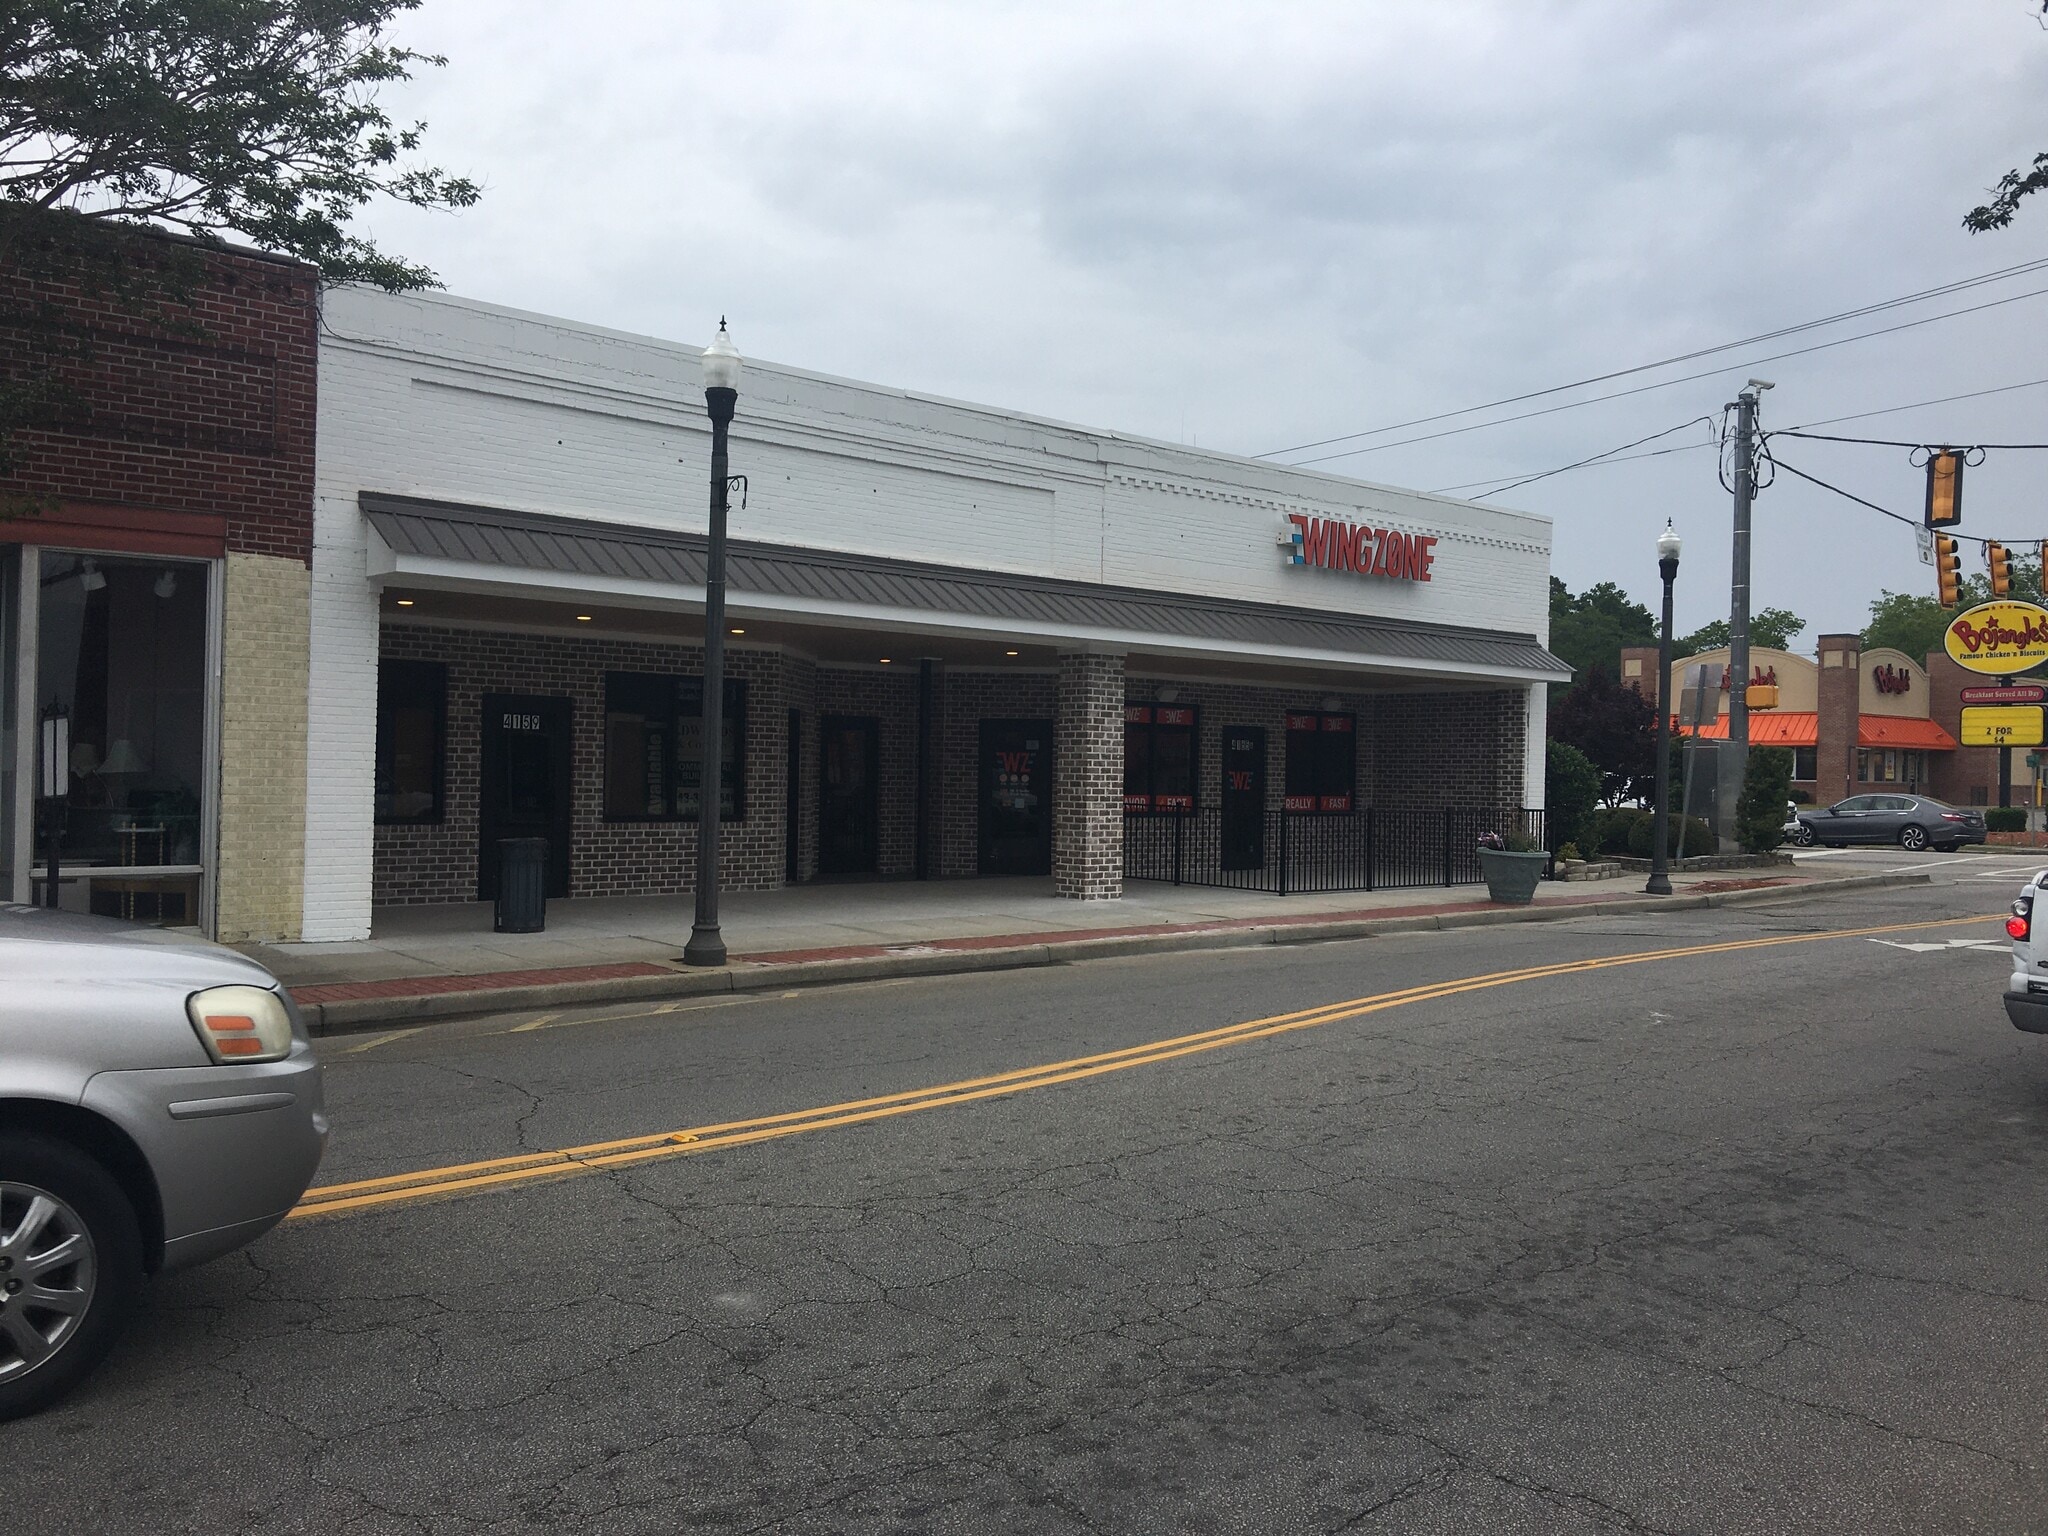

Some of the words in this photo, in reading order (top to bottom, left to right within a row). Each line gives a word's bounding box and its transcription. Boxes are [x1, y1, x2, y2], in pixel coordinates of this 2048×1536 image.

[1985, 651, 2011, 659] Chicken
[2020, 649, 2046, 658] Biscuits
[1965, 691, 1994, 699] Breakfast
[2028, 690, 2040, 698] Day
[503, 713, 540, 730] 4159
[1986, 727, 1992, 735] 2
[1995, 727, 2013, 735] FOR
[1994, 736, 2005, 744] $4
[648, 733, 663, 816] Available
[1285, 798, 1312, 809] REALLY
[1328, 798, 1347, 809] FAST
